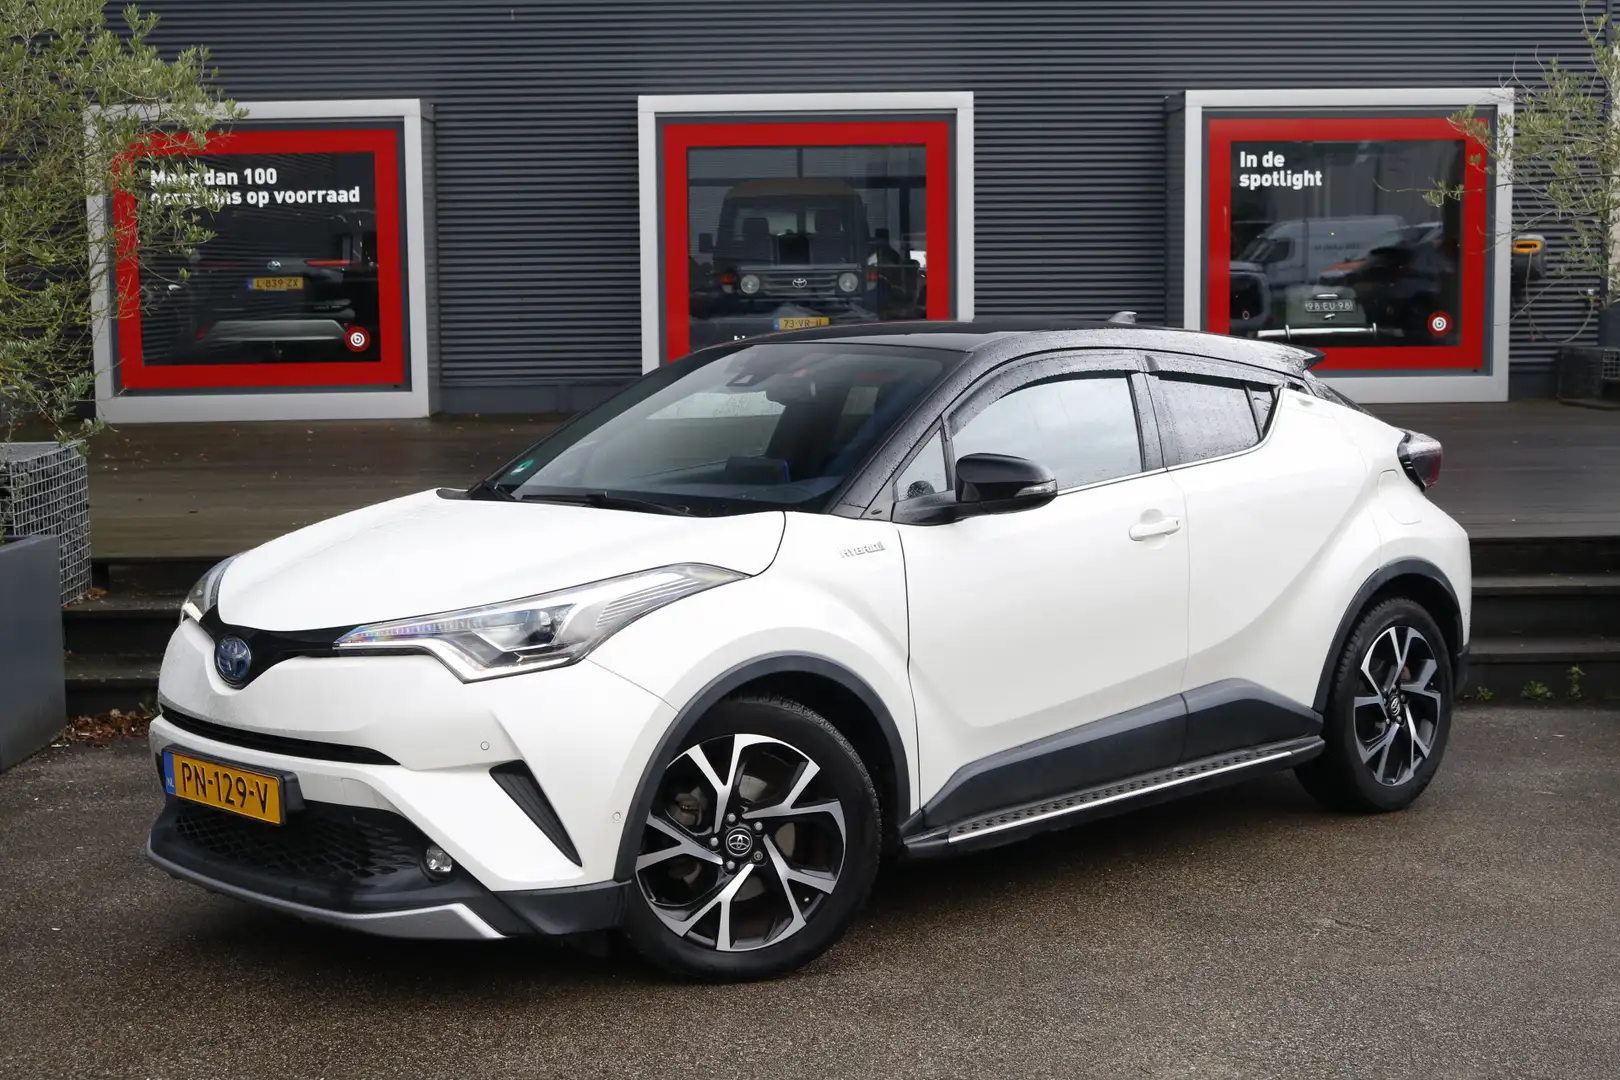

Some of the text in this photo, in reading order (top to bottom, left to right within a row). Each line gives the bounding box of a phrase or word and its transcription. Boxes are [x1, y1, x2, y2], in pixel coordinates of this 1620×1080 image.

[1240, 151, 1285, 168] In de
[204, 169, 238, 186] dan
[243, 168, 277, 185] 100
[1239, 170, 1322, 190] spotlight
[246, 191, 269, 207] op
[273, 186, 360, 203] voorraad
[181, 761, 268, 814] PN-129-V
